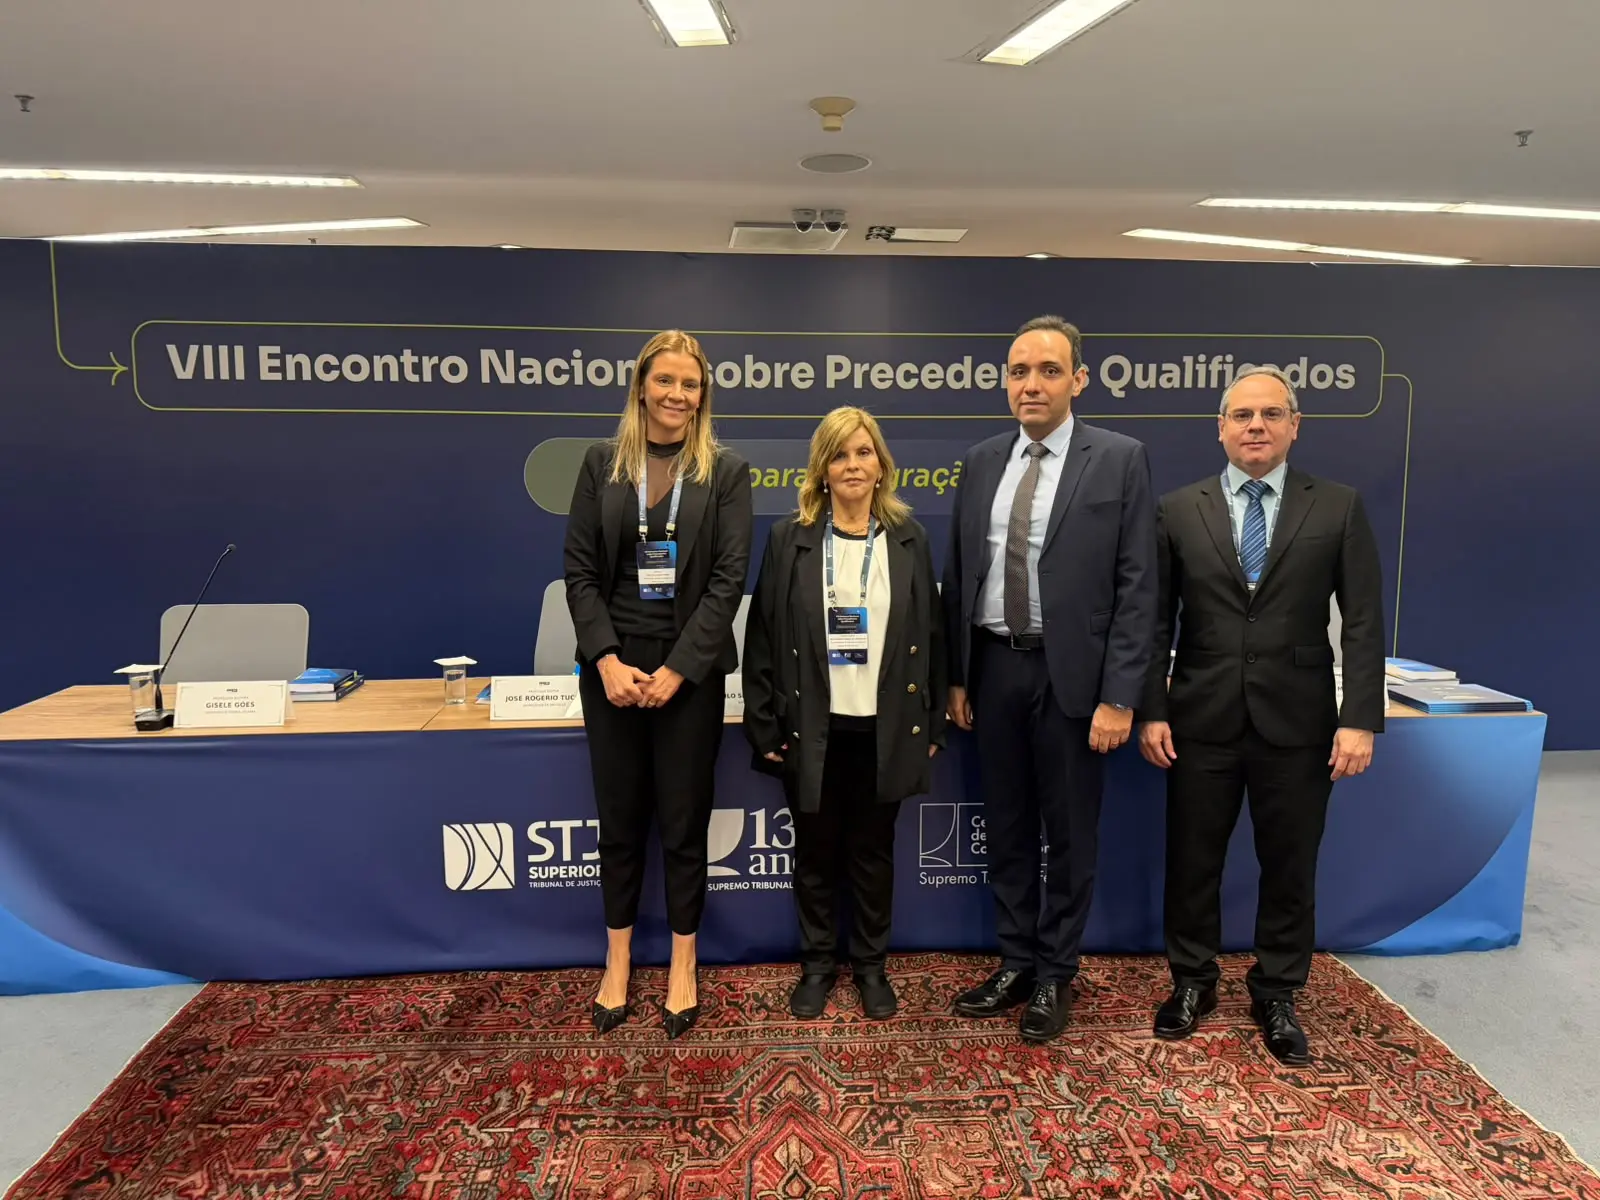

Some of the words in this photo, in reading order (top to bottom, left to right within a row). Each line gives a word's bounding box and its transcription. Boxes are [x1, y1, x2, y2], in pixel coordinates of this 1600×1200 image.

[166, 344, 245, 380] VIII
[258, 345, 468, 384] Encontro
[480, 348, 637, 387] Nacion
[749, 807, 796, 849] 13
[748, 853, 795, 875] an
[528, 881, 564, 889] TRIBUNAL
[576, 879, 602, 888] JUSTIÇ
[707, 881, 750, 891] SUPREMO
[751, 881, 794, 890] TRIBUNAL
[919, 872, 977, 888] Supremo
